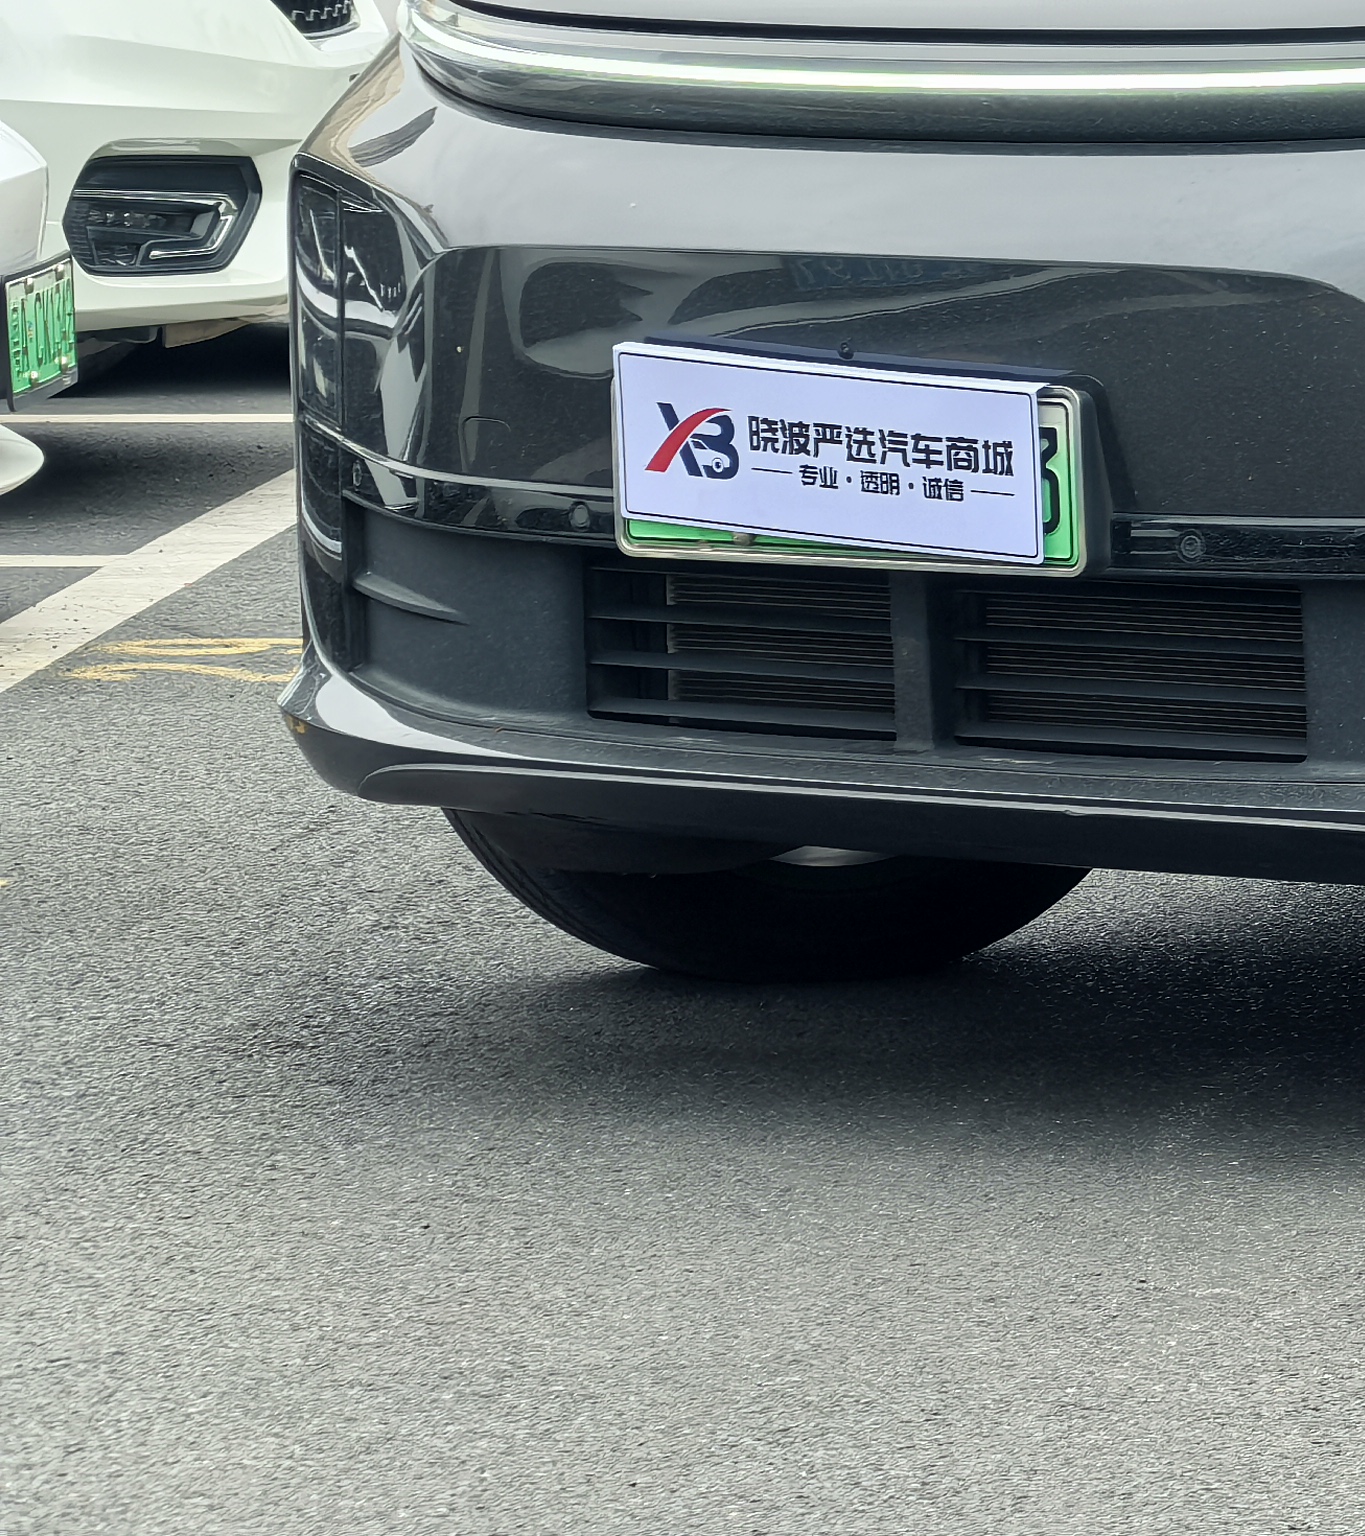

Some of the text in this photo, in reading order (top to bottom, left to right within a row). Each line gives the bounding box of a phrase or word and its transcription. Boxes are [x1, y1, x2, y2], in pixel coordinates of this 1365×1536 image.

[747, 415, 1015, 477] 晓波严选汽车商城
